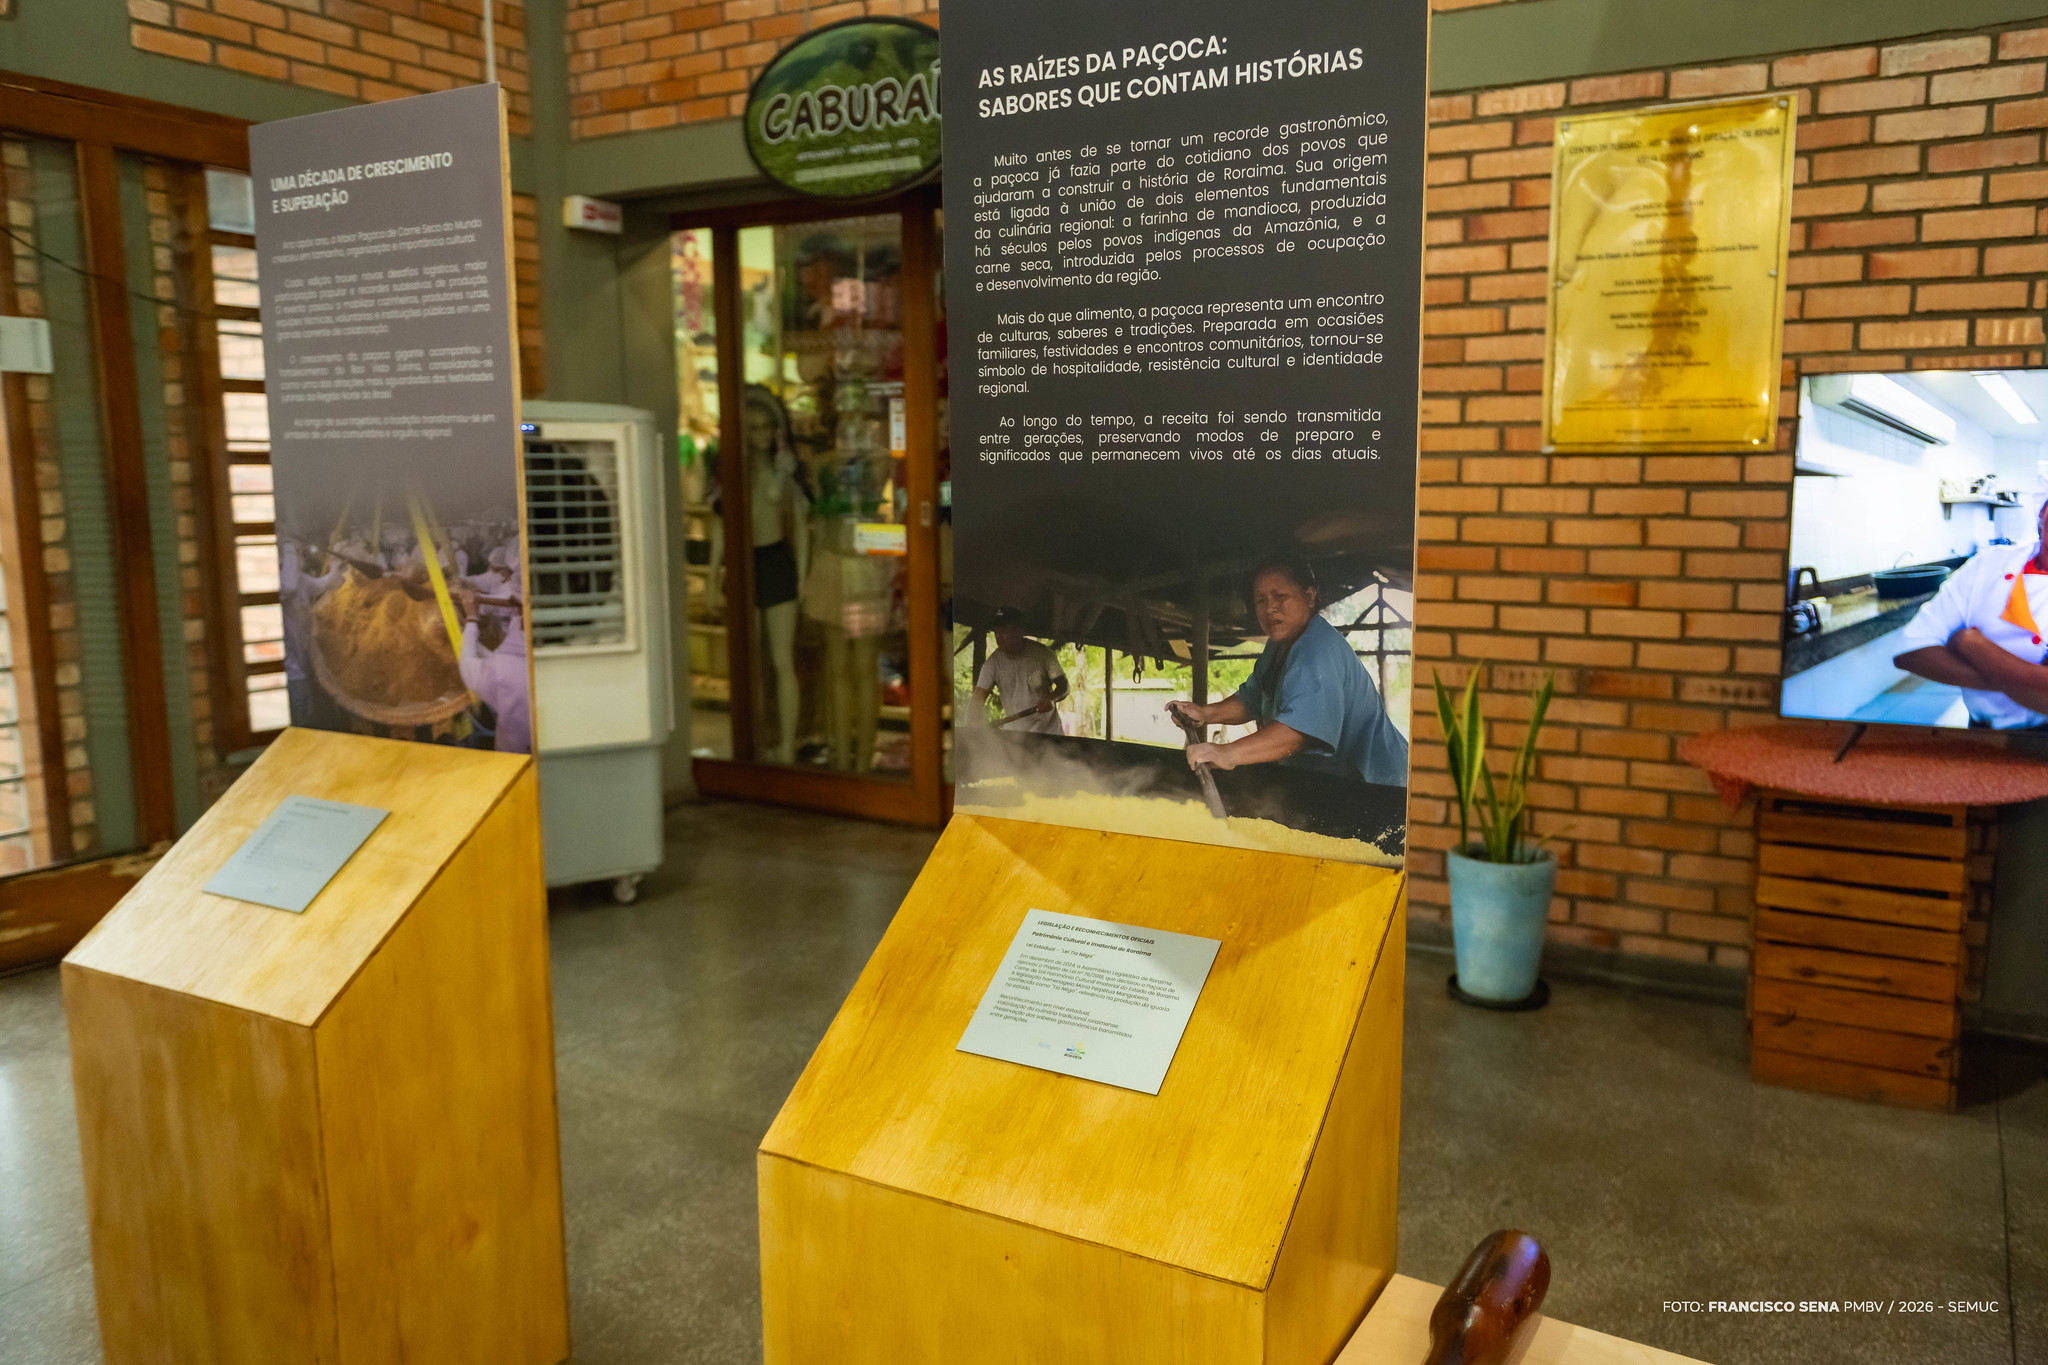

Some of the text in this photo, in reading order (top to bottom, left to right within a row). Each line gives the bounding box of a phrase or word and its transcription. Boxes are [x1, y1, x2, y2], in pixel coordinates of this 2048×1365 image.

[978, 35, 1227, 89] AS RAÍZES DA PAÇOCA:
[979, 47, 1363, 118] SABORES QUE CONTAM HISTÓRIAS
[994, 111, 1388, 167] Muito antes de se tornar um recorde gastronômico,
[272, 152, 452, 191] UMA DÉCADA DE CRESCIMENTO
[973, 133, 1388, 189] a paçoca já fazia parte do cotidiano dos povos que
[973, 153, 1387, 208] ajudaram a construir a história de Roraima. Sua origem
[974, 170, 1387, 222] está ligada à união de dois elementos fundamentais
[273, 188, 348, 213] E SUPERAÇÃO
[974, 191, 1386, 240] da culinária regional: a farinha de mandioca, produzida
[975, 214, 1386, 257] há séculos pelos povos indígenas da Amazônia, e a
[975, 232, 1386, 274] carne seca, introduzida pelos processos de ocupação
[975, 268, 1161, 292] e desenvolvimento da região.
[997, 292, 1384, 326] Mais do que alimento, a paçoca representa um encontro
[977, 311, 1384, 343] de culturas, saberes e tradições. Preparada em ocasiões
[977, 333, 1383, 360] familiares, festividades e encontros comunitários, tornou-se
[978, 350, 1383, 377] símbolo de hospitalidade, resistência cultural e identidade
[978, 380, 1029, 397] regional.
[999, 408, 1381, 430] Ao longo do tempo, a receita foi sendo transmitida
[1031, 931, 1062, 940] Patrimônio
[1091, 942, 1117, 950] Imaterial
[1126, 948, 1151, 956] Roraima
[1038, 920, 1070, 929] LEGISLAÇÃO
[1075, 927, 1129, 939] RECONHECIMENTOS
[997, 1000, 1026, 1009] Valorização
[1035, 1007, 1058, 1015] culinária
[1058, 1012, 1086, 1021] tradicional
[1000, 994, 1042, 1005] Reconhecimento
